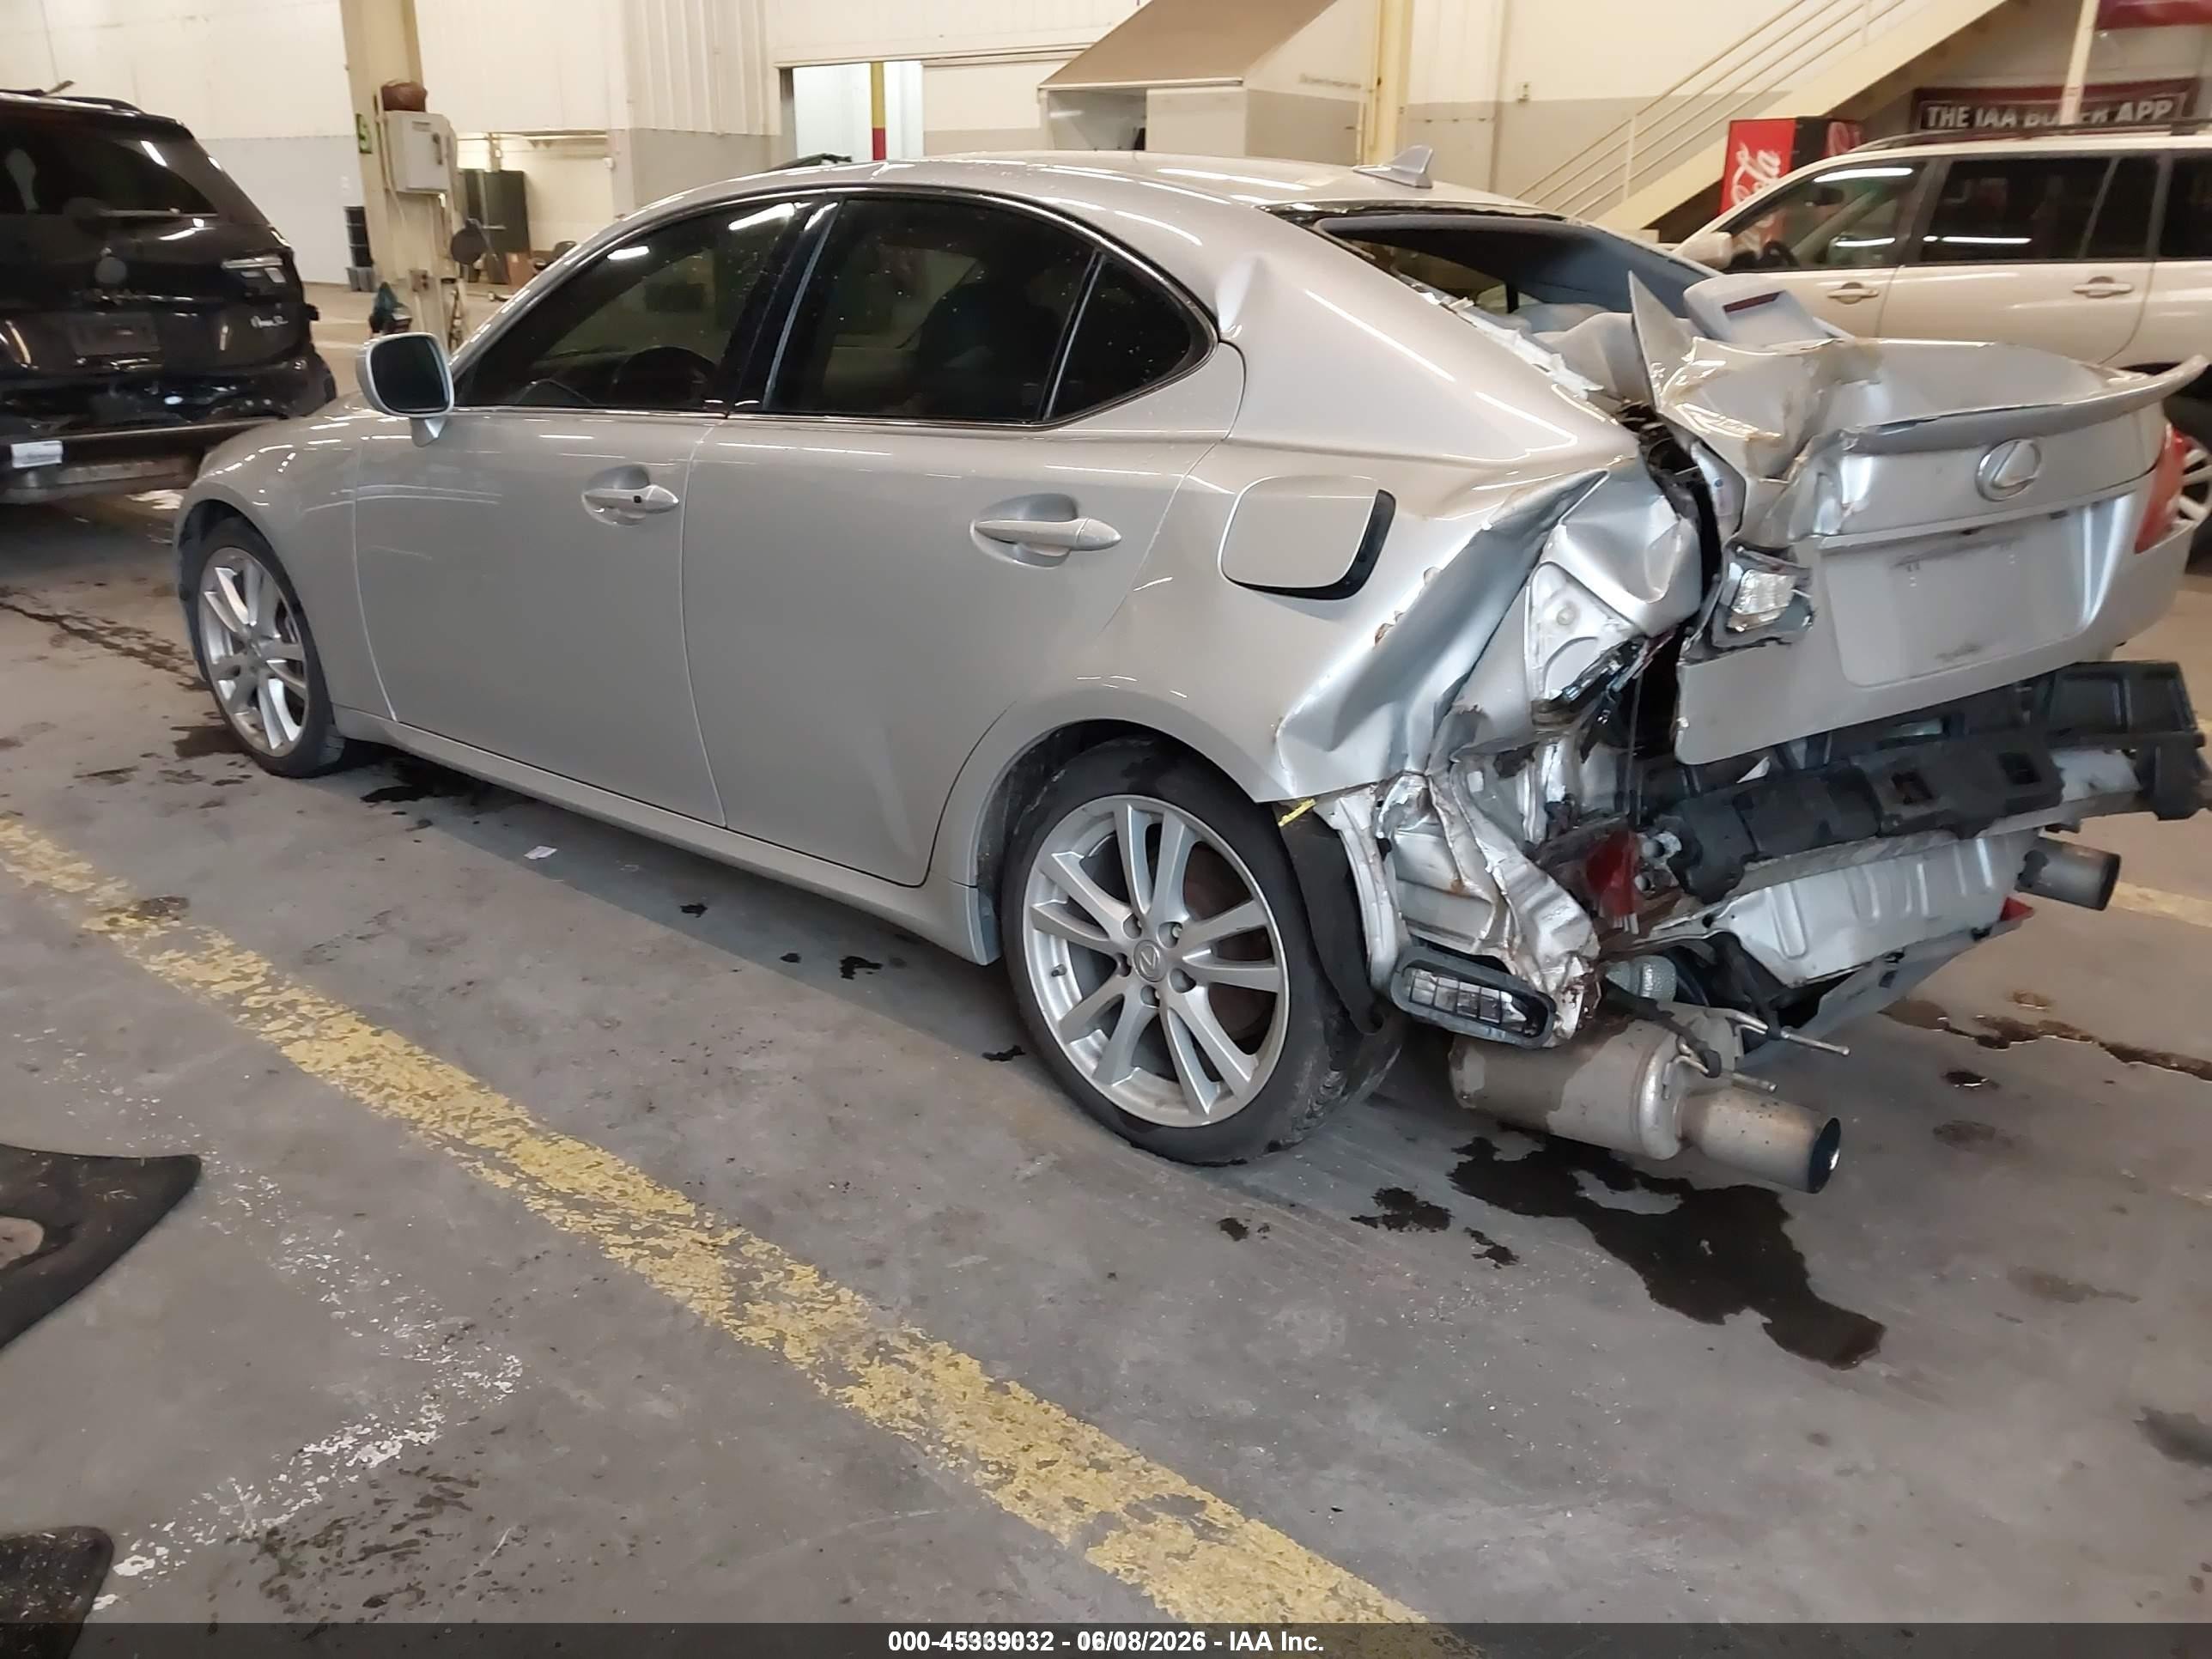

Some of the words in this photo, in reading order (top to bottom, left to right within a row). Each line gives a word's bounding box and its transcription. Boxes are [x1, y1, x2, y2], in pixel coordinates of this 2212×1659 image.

[1926, 105, 1971, 128] THE
[1976, 106, 2017, 127] IAA
[2114, 99, 2175, 122] APP
